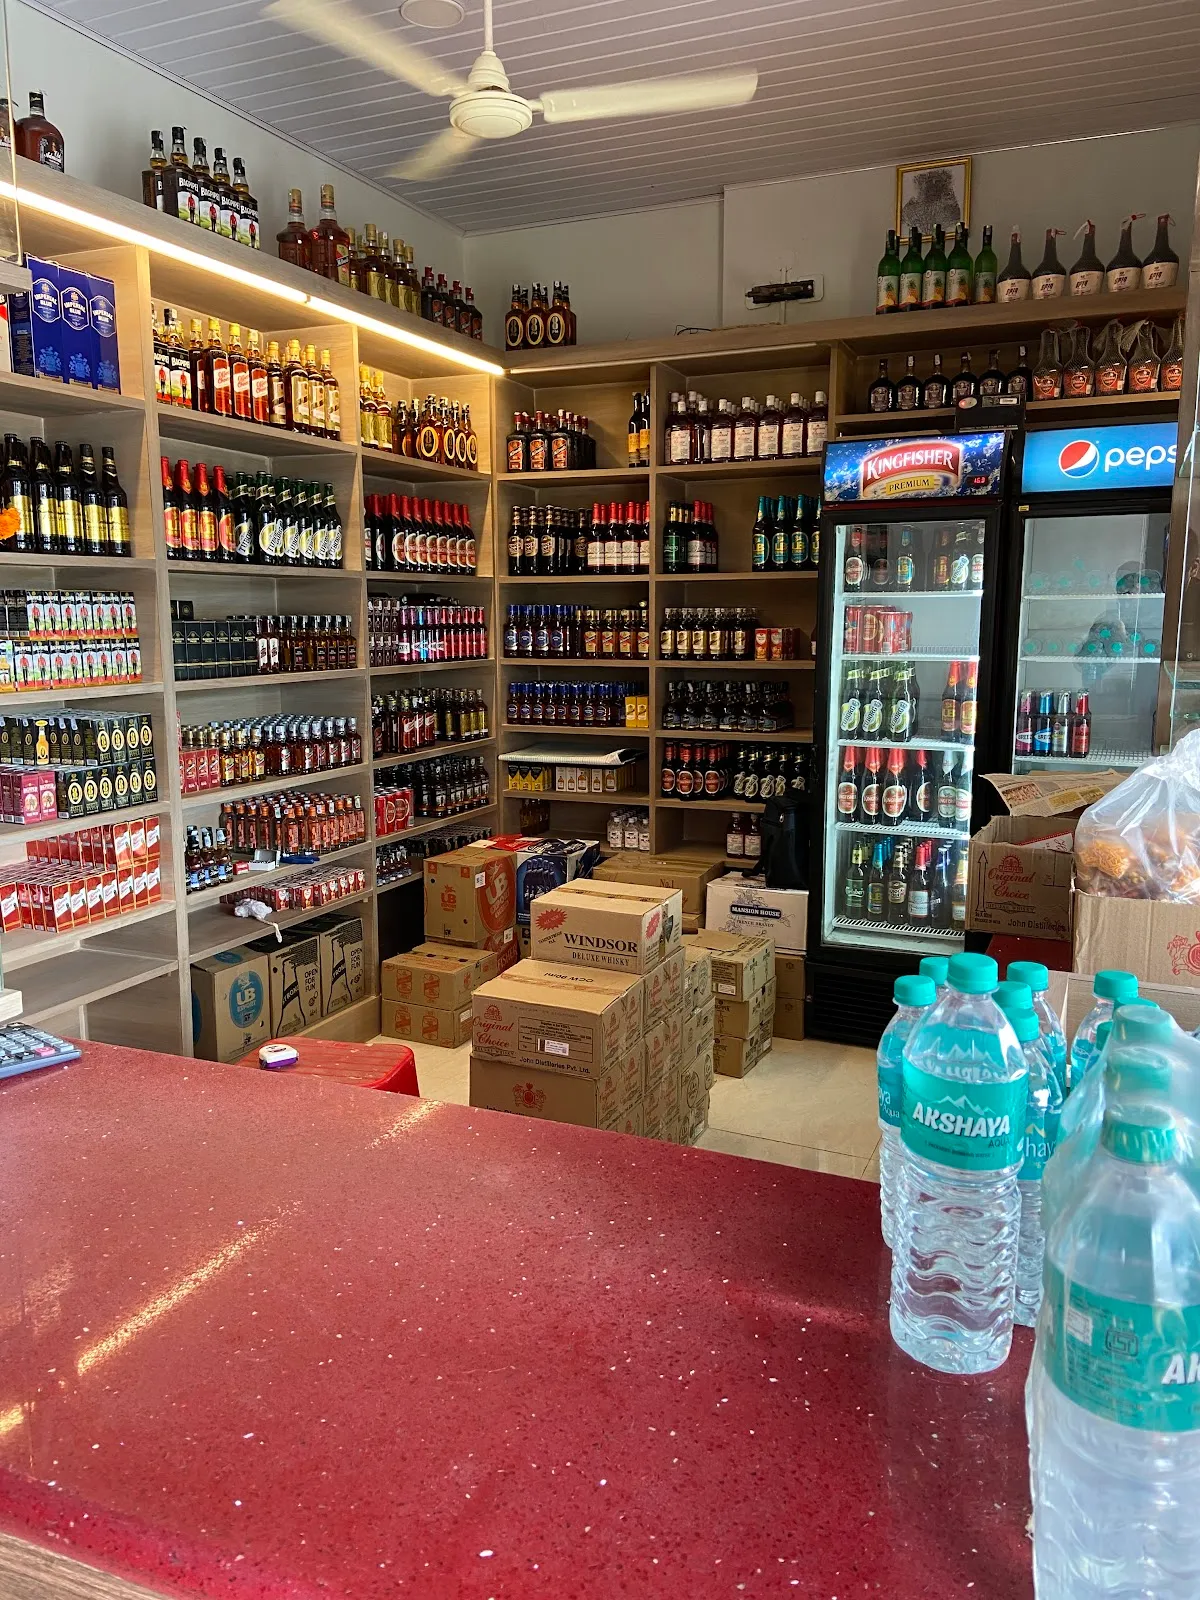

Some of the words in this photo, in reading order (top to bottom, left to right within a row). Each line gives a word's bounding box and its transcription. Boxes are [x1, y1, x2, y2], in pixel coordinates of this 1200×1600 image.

[34, 293, 57, 305] IMPERIAL
[64, 302, 86, 313] IMPERIAL
[92, 310, 113, 320] IMPERIAL
[866, 450, 954, 480] KINGFISHER
[1104, 445, 1177, 472] peps
[889, 478, 930, 492] PREMIUM
[842, 706, 856, 728] TUBORG
[863, 706, 878, 730] TUBORG
[988, 868, 1036, 886] Original
[486, 872, 508, 905] UB
[992, 884, 1030, 900] Choice
[732, 906, 759, 915] MANSION
[760, 909, 780, 918] HOUSE
[1008, 919, 1026, 928] John
[564, 933, 638, 953] WINDSOR
[572, 952, 600, 962] DELUXE
[602, 956, 630, 967] WHISKY
[304, 968, 318, 979] OPEN
[305, 984, 316, 992] FUN
[236, 988, 256, 1006] UB
[473, 1016, 514, 1032] Original
[476, 1032, 510, 1048] Choice
[520, 1056, 534, 1064] John
[535, 1058, 565, 1070] Distilleries
[566, 1064, 578, 1072] Pvt.
[580, 1066, 590, 1074] Ltd.
[912, 1101, 1010, 1138] AKSHAYA
